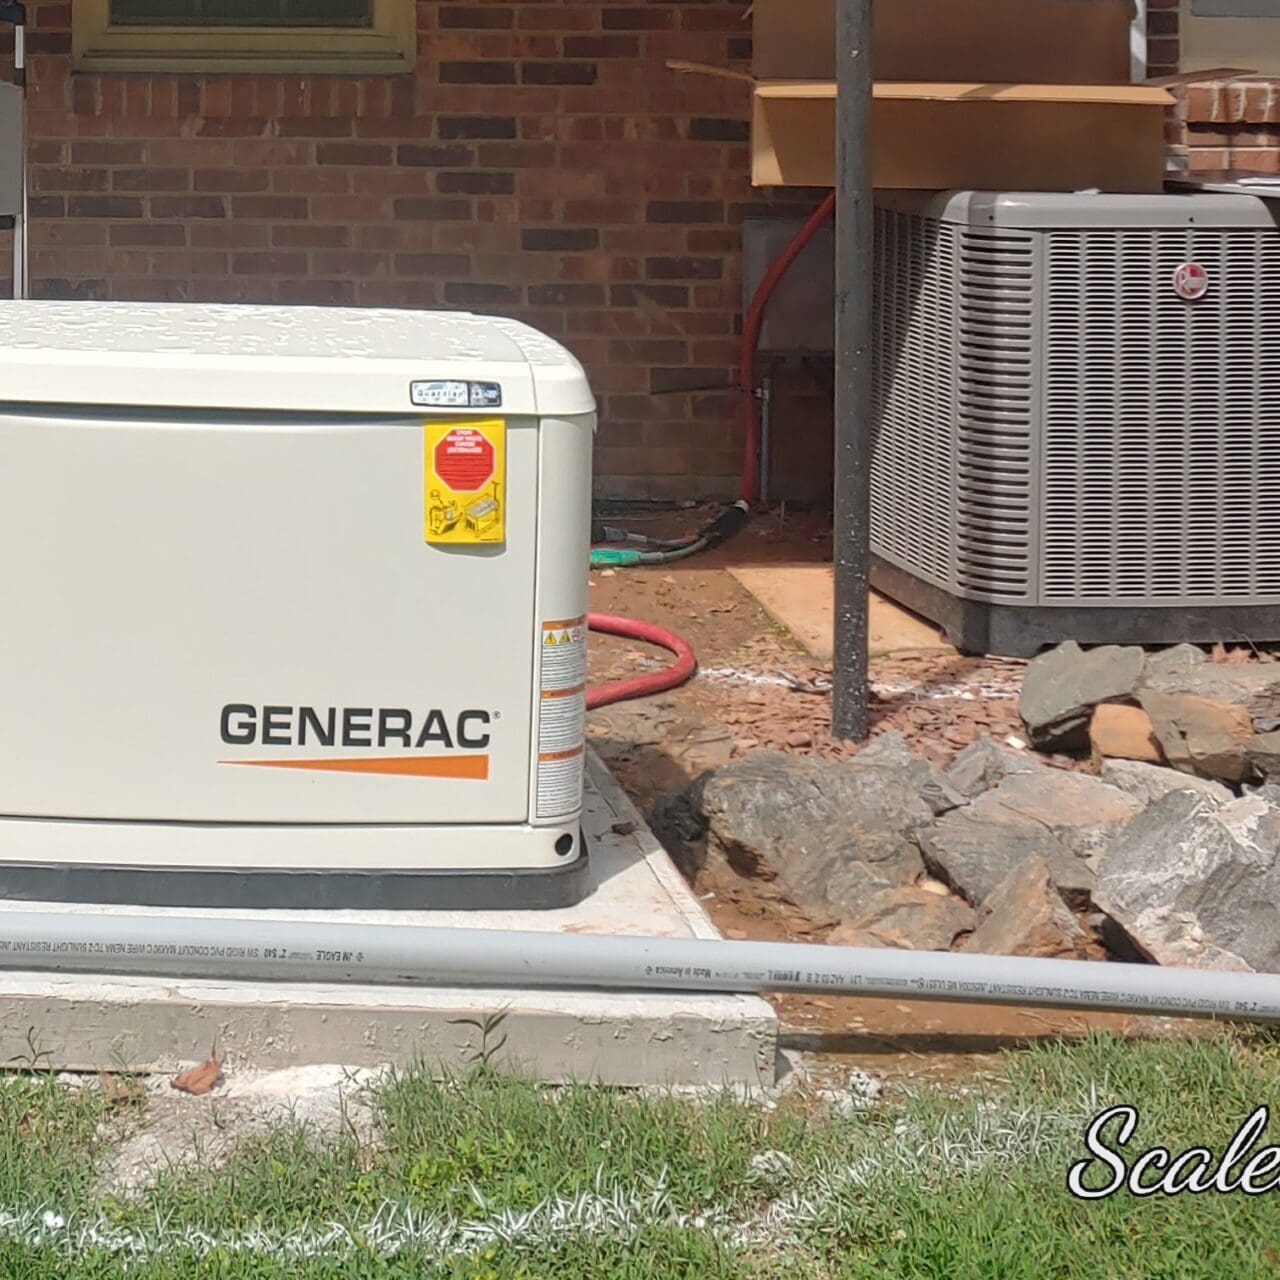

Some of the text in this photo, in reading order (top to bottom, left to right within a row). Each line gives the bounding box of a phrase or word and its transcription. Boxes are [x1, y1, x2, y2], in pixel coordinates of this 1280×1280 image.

[220, 703, 490, 749] GENERAC
[13, 941, 51, 952] RESISTANT
[53, 942, 87, 953] SUNLIGHT
[178, 945, 209, 956] CONDUIT
[316, 950, 341, 962] EAGLE
[656, 966, 684, 977] America
[693, 967, 712, 978] Made
